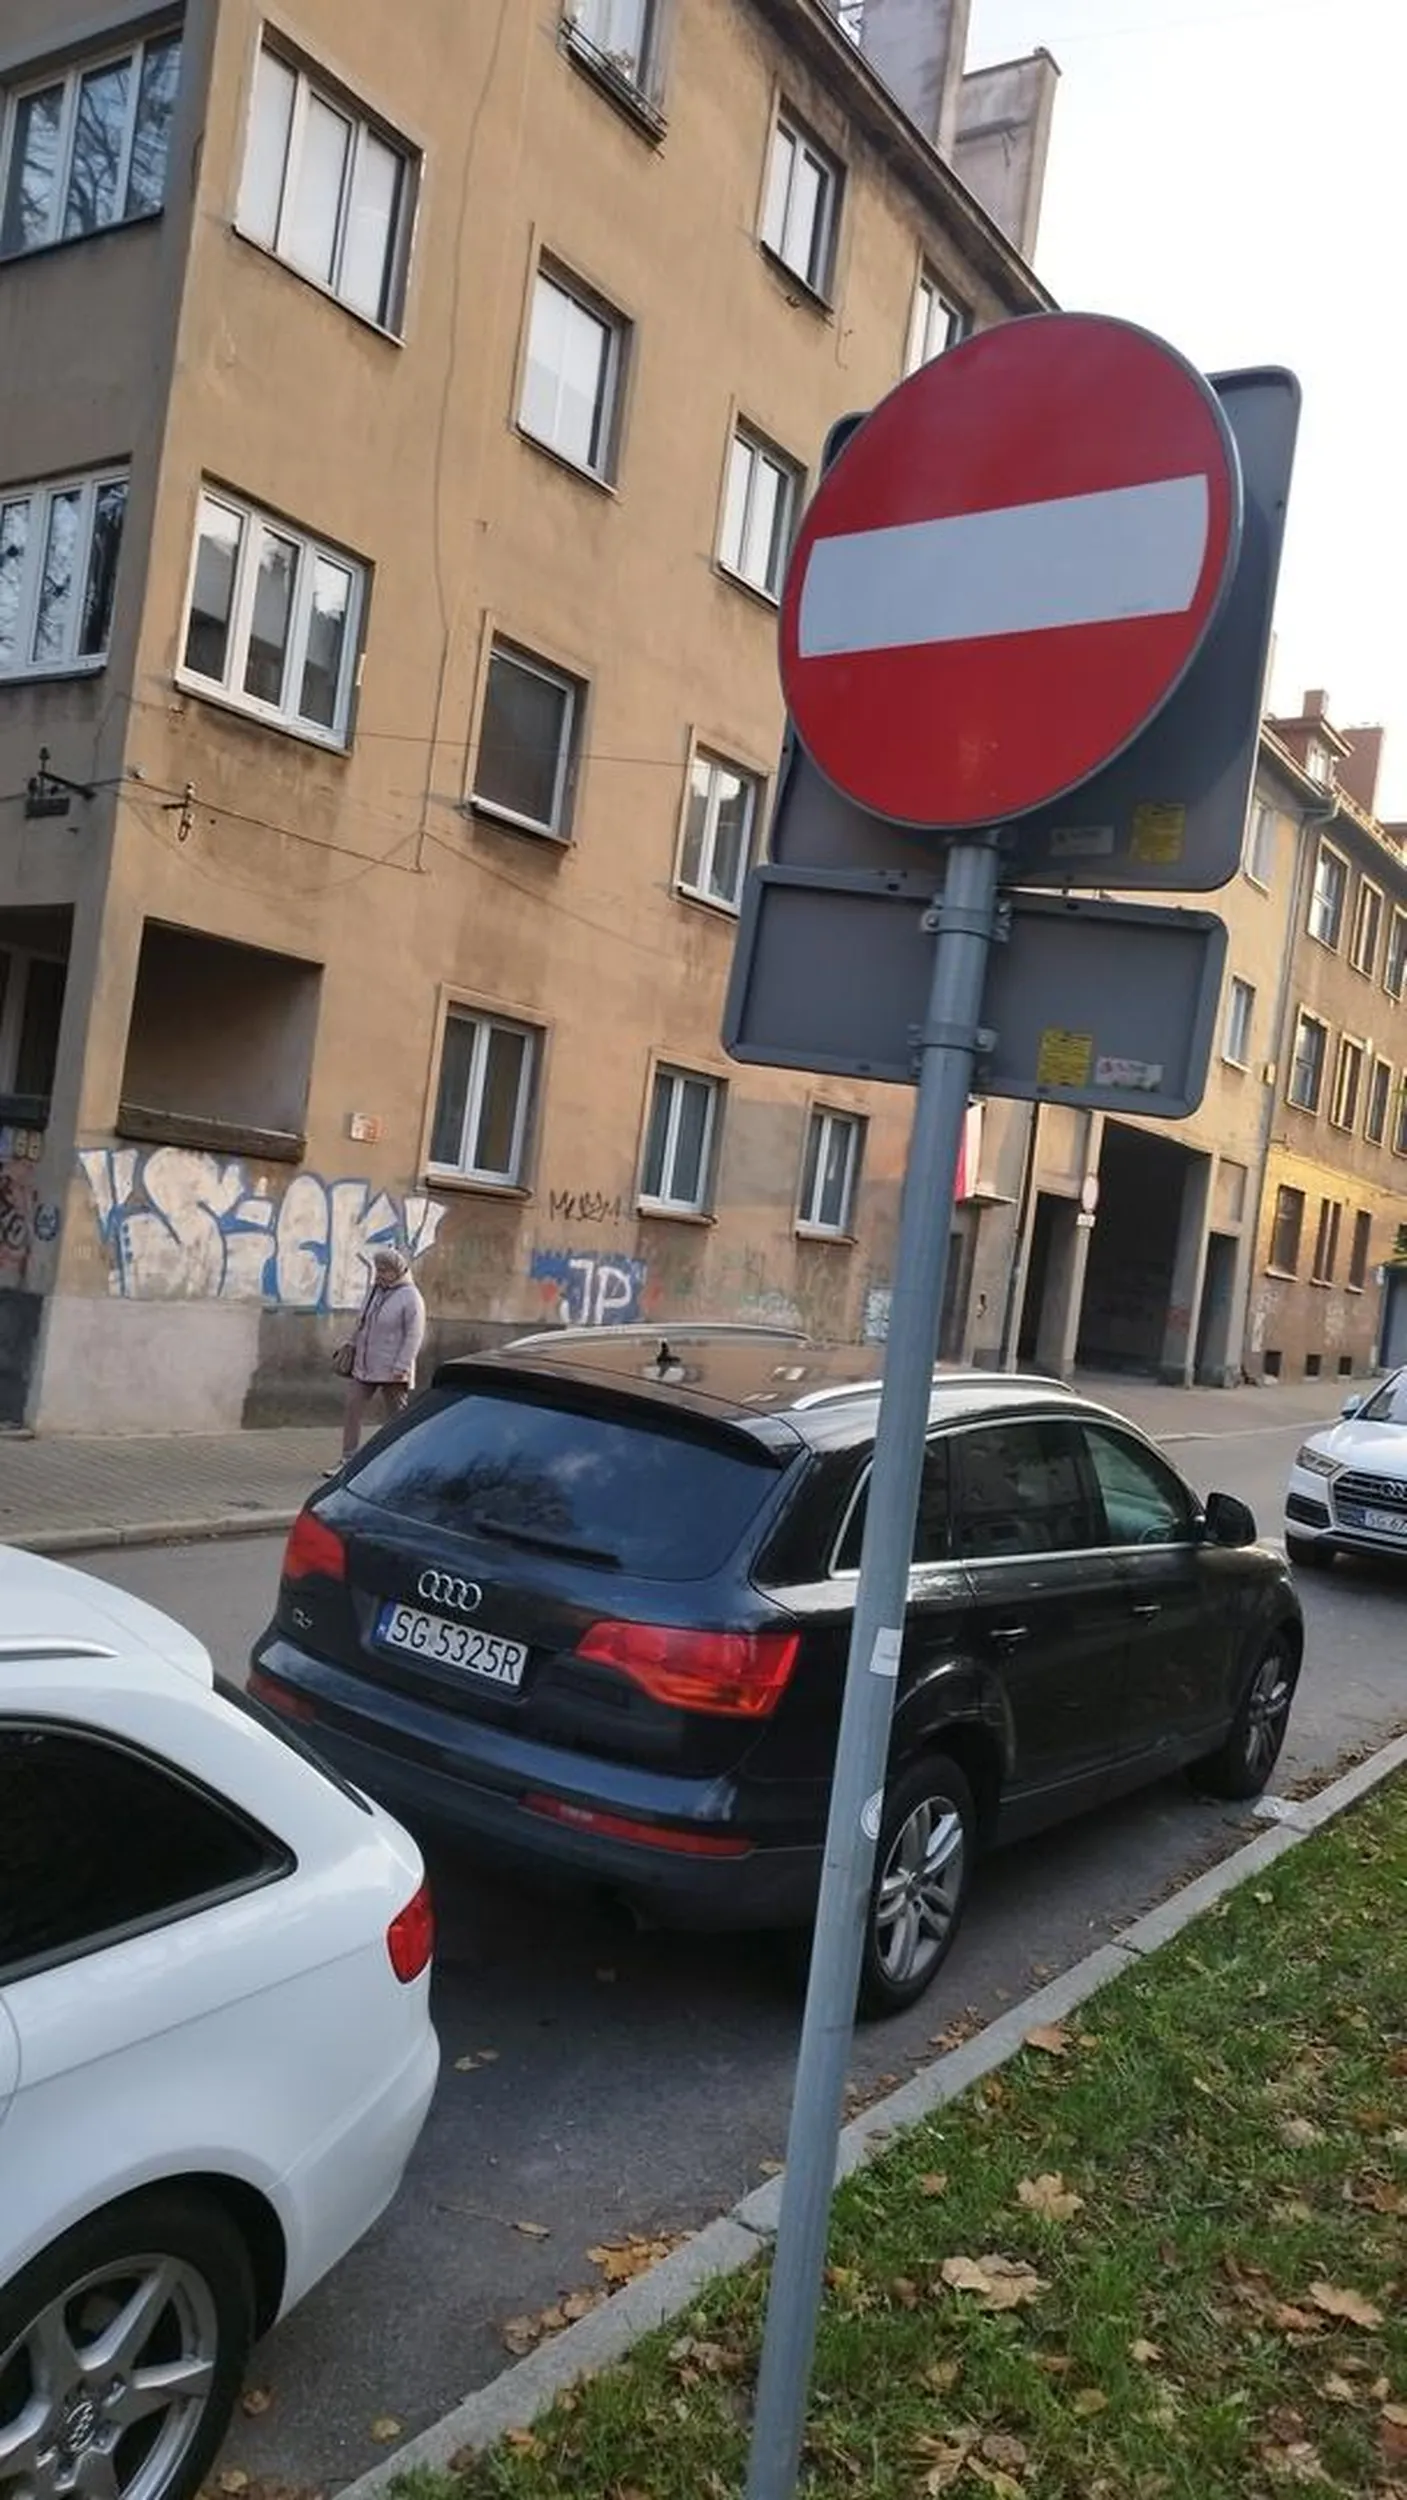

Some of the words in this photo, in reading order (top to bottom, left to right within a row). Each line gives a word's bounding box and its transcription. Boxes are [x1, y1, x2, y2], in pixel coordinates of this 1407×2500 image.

[559, 1258, 633, 1325] JP
[392, 1610, 430, 1649] SG
[434, 1623, 522, 1682] 5325R
